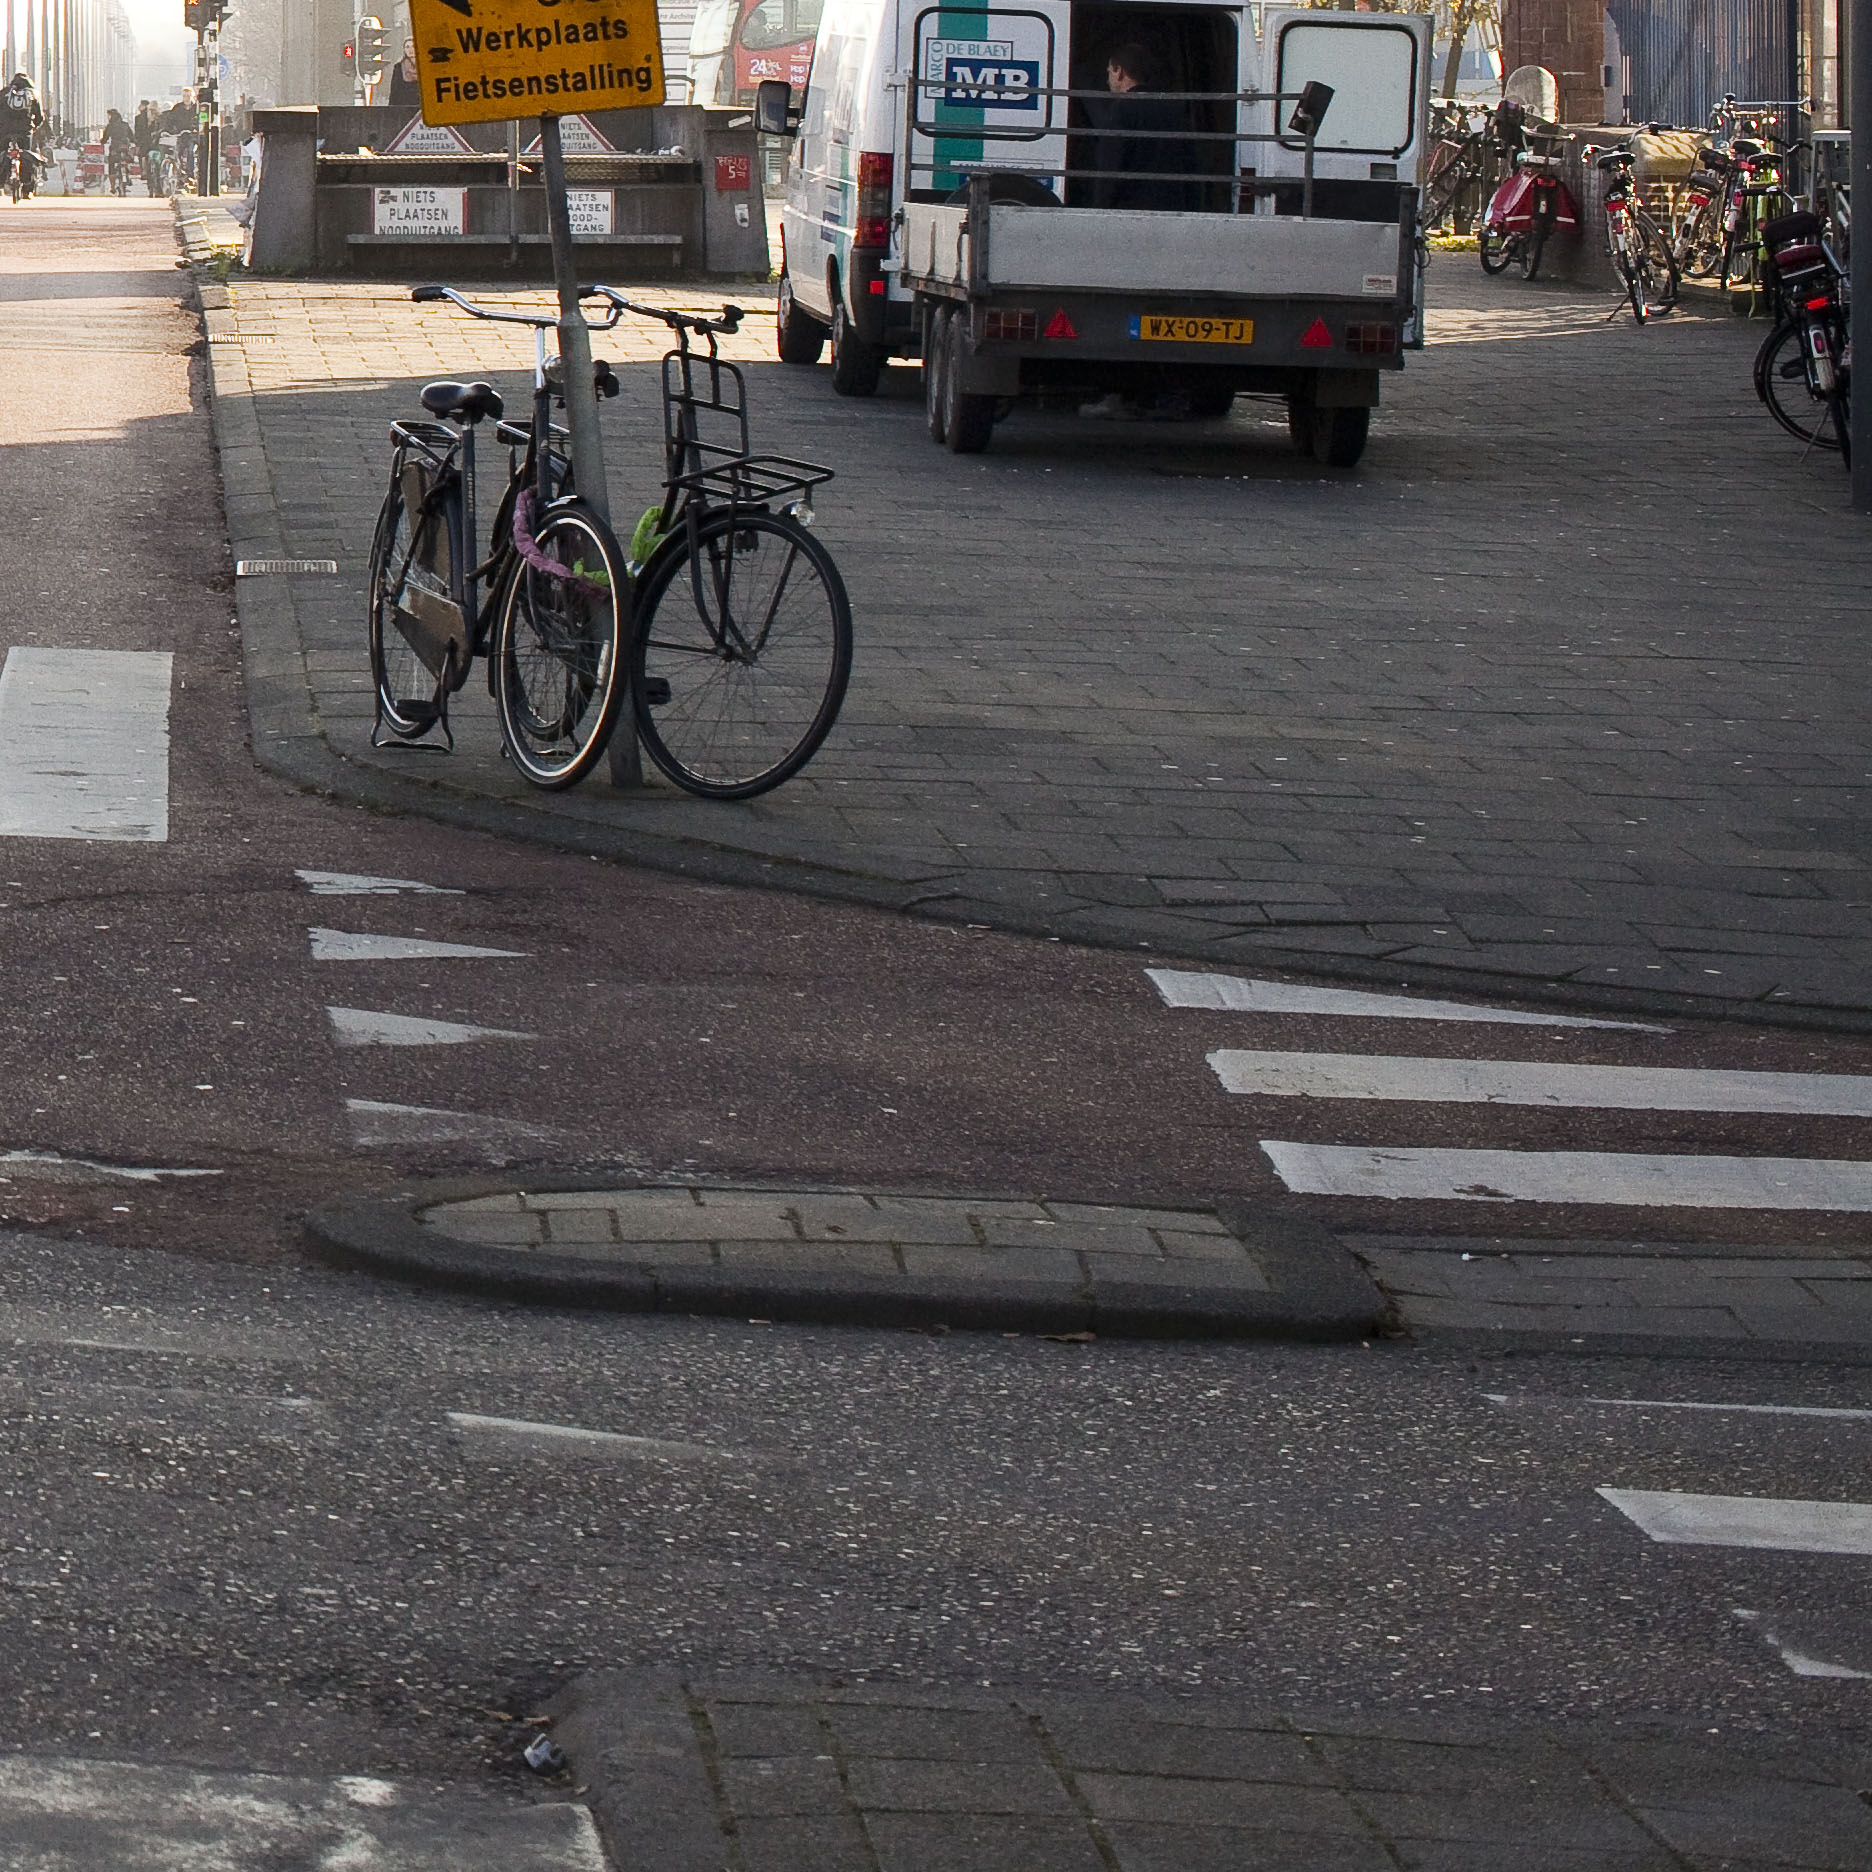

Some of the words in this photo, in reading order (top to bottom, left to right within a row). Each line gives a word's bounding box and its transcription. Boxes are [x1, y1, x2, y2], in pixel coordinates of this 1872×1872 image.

[456, 15, 628, 54] Werkplaats
[946, 43, 964, 56] DE
[967, 43, 1009, 58] BLAEY
[435, 62, 653, 103] Fietsenstalling
[952, 66, 1031, 101] MB
[402, 190, 436, 203] NIETS
[389, 208, 448, 221] PLAATSEN
[568, 203, 609, 212] AATSEN
[571, 214, 598, 222] OOD-
[569, 223, 605, 232] TGANG
[1149, 318, 1245, 341] WX-09-TJ
